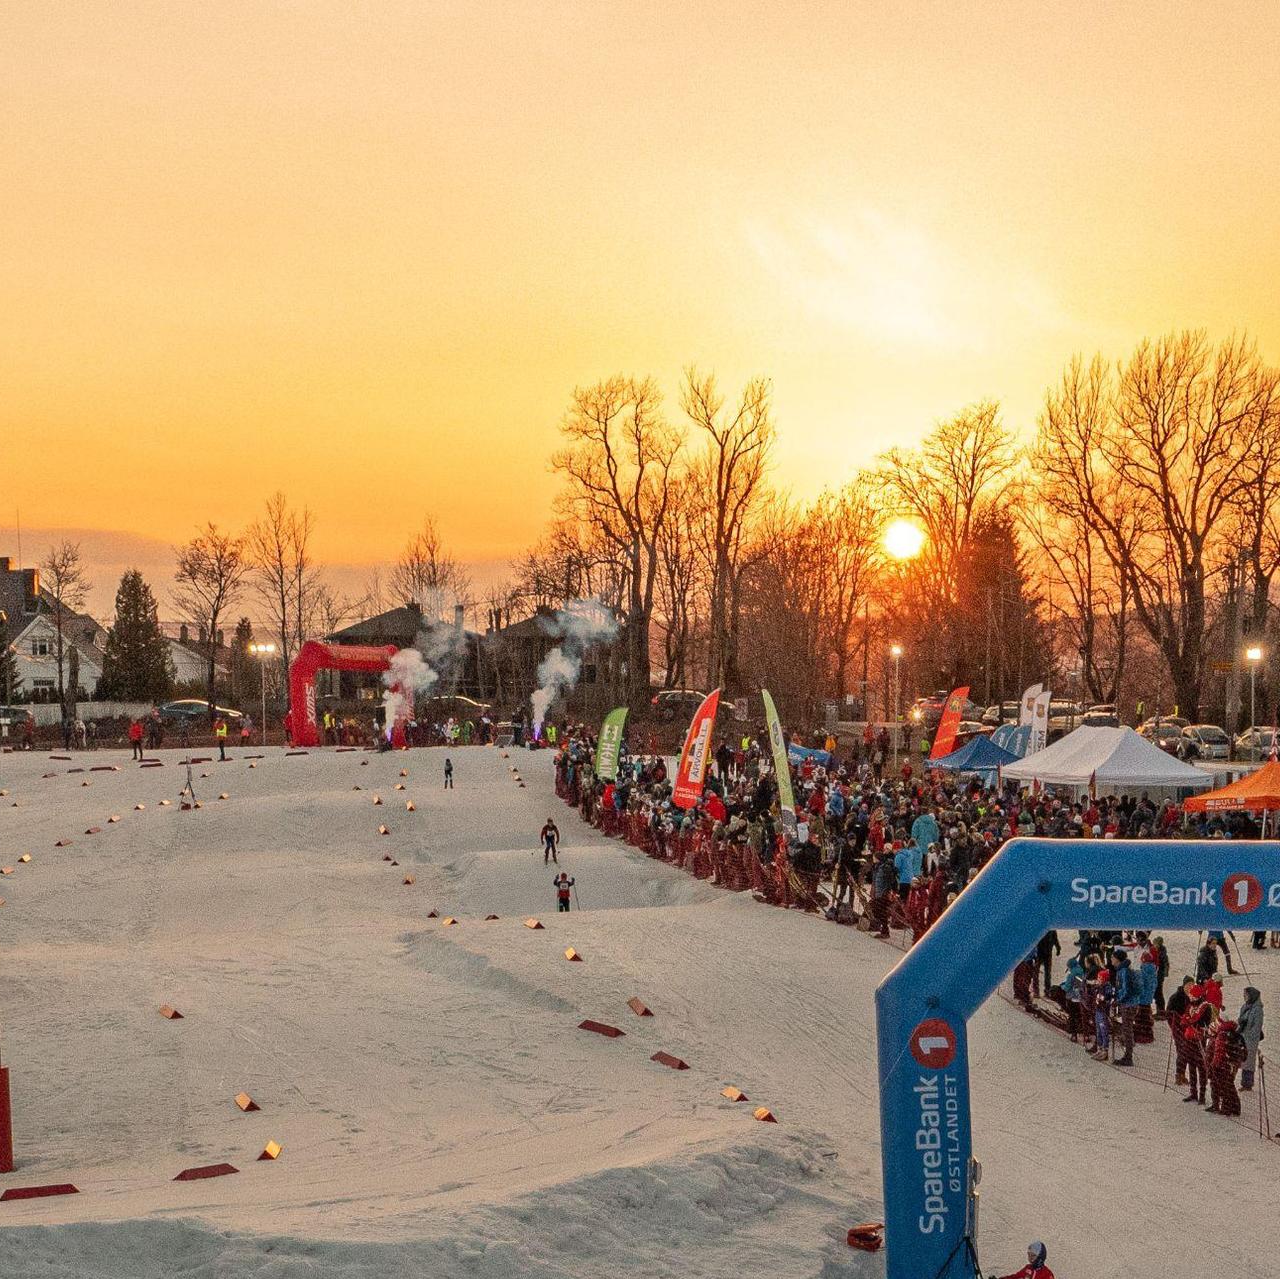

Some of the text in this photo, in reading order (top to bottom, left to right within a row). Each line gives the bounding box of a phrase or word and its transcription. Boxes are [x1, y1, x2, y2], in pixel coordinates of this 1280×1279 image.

[1070, 878, 1217, 907] SpareBank
[1233, 880, 1250, 907] 1
[913, 1074, 949, 1234] SpareBank
[944, 1074, 962, 1193] ØSTLANDET
